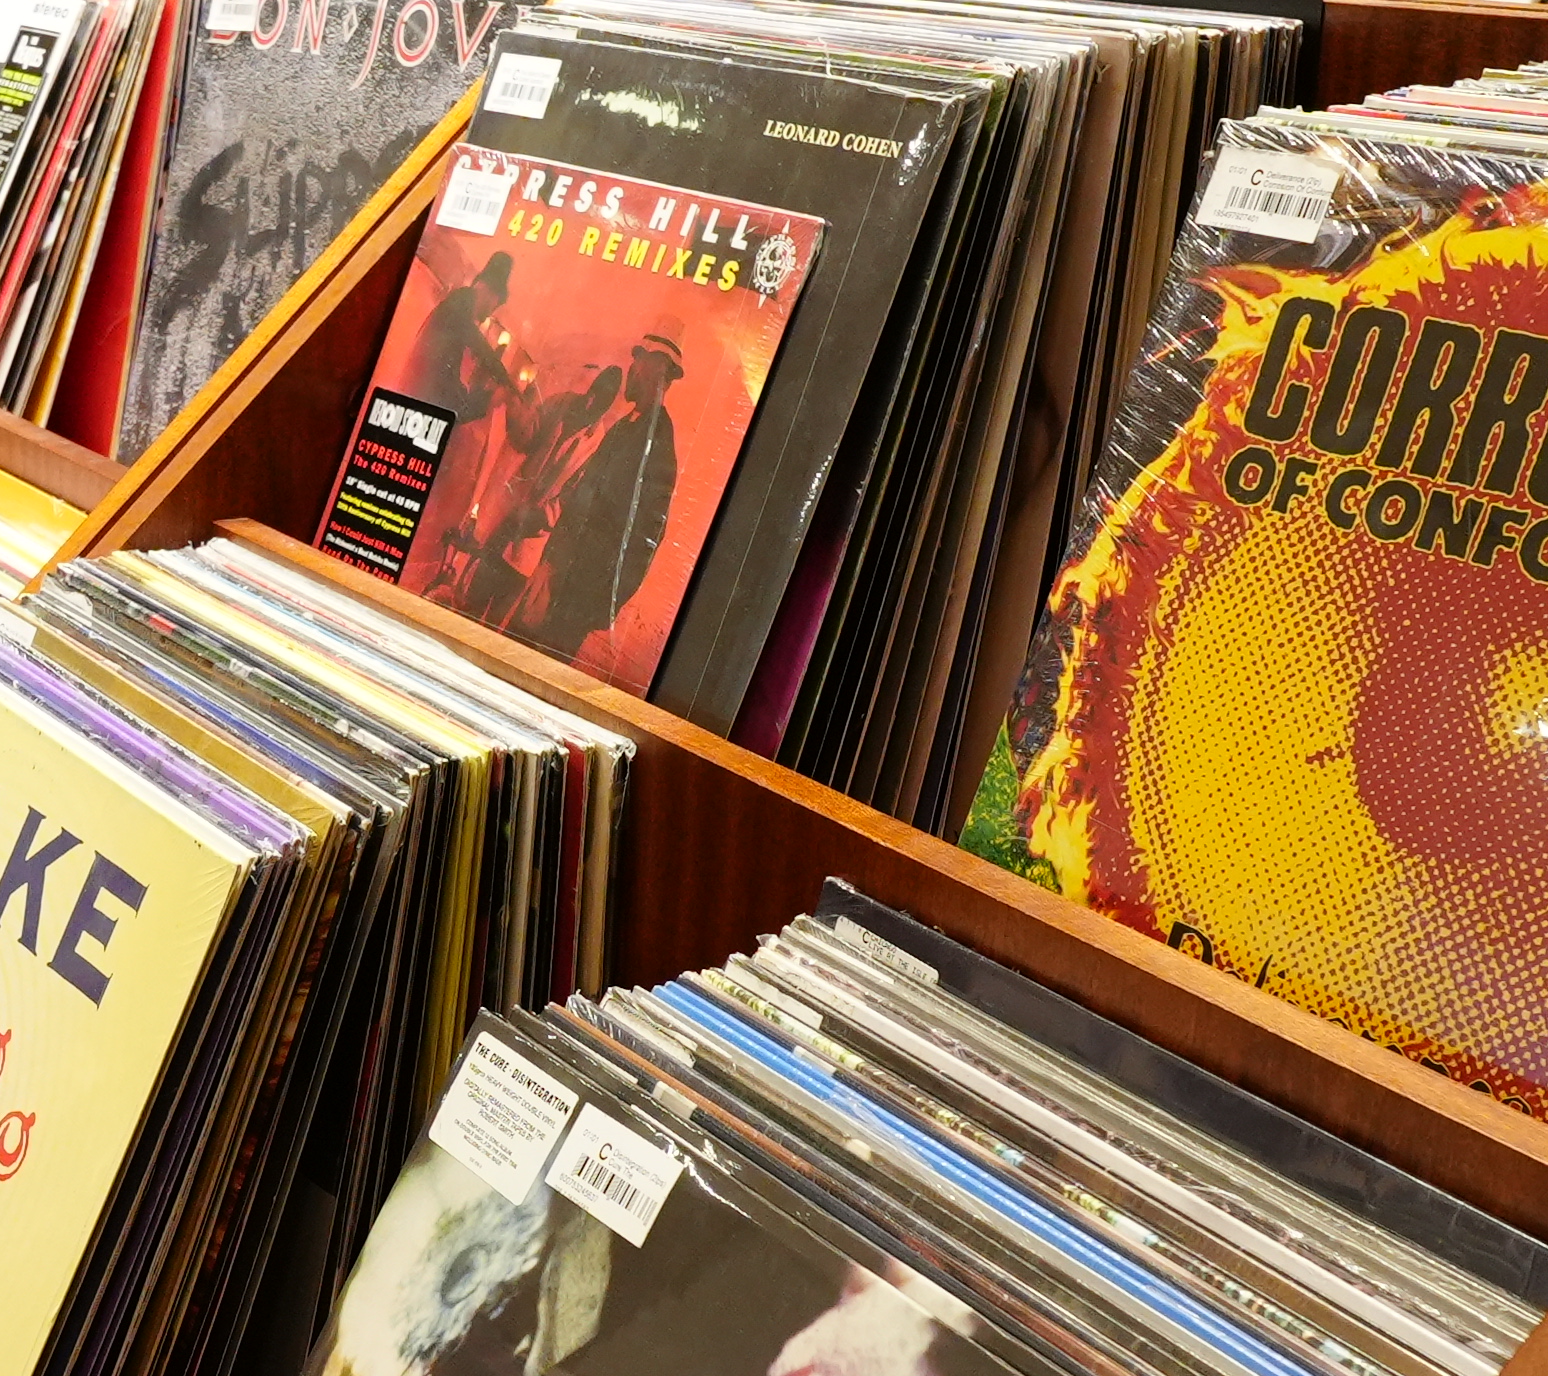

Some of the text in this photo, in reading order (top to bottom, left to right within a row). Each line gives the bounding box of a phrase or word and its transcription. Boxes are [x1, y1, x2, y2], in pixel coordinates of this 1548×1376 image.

[33, 2, 69, 20] stereo
[764, 120, 904, 159] LEONARD COHEN
[648, 195, 753, 251] HILL
[507, 210, 740, 293] 420 REMIXES
[354, 455, 427, 492] The 420 Remixes
[358, 439, 433, 478] CYPRESS HILL
[1223, 446, 1322, 522] OF
[476, 1042, 571, 1116] THE CURE DISINTEGRATION
